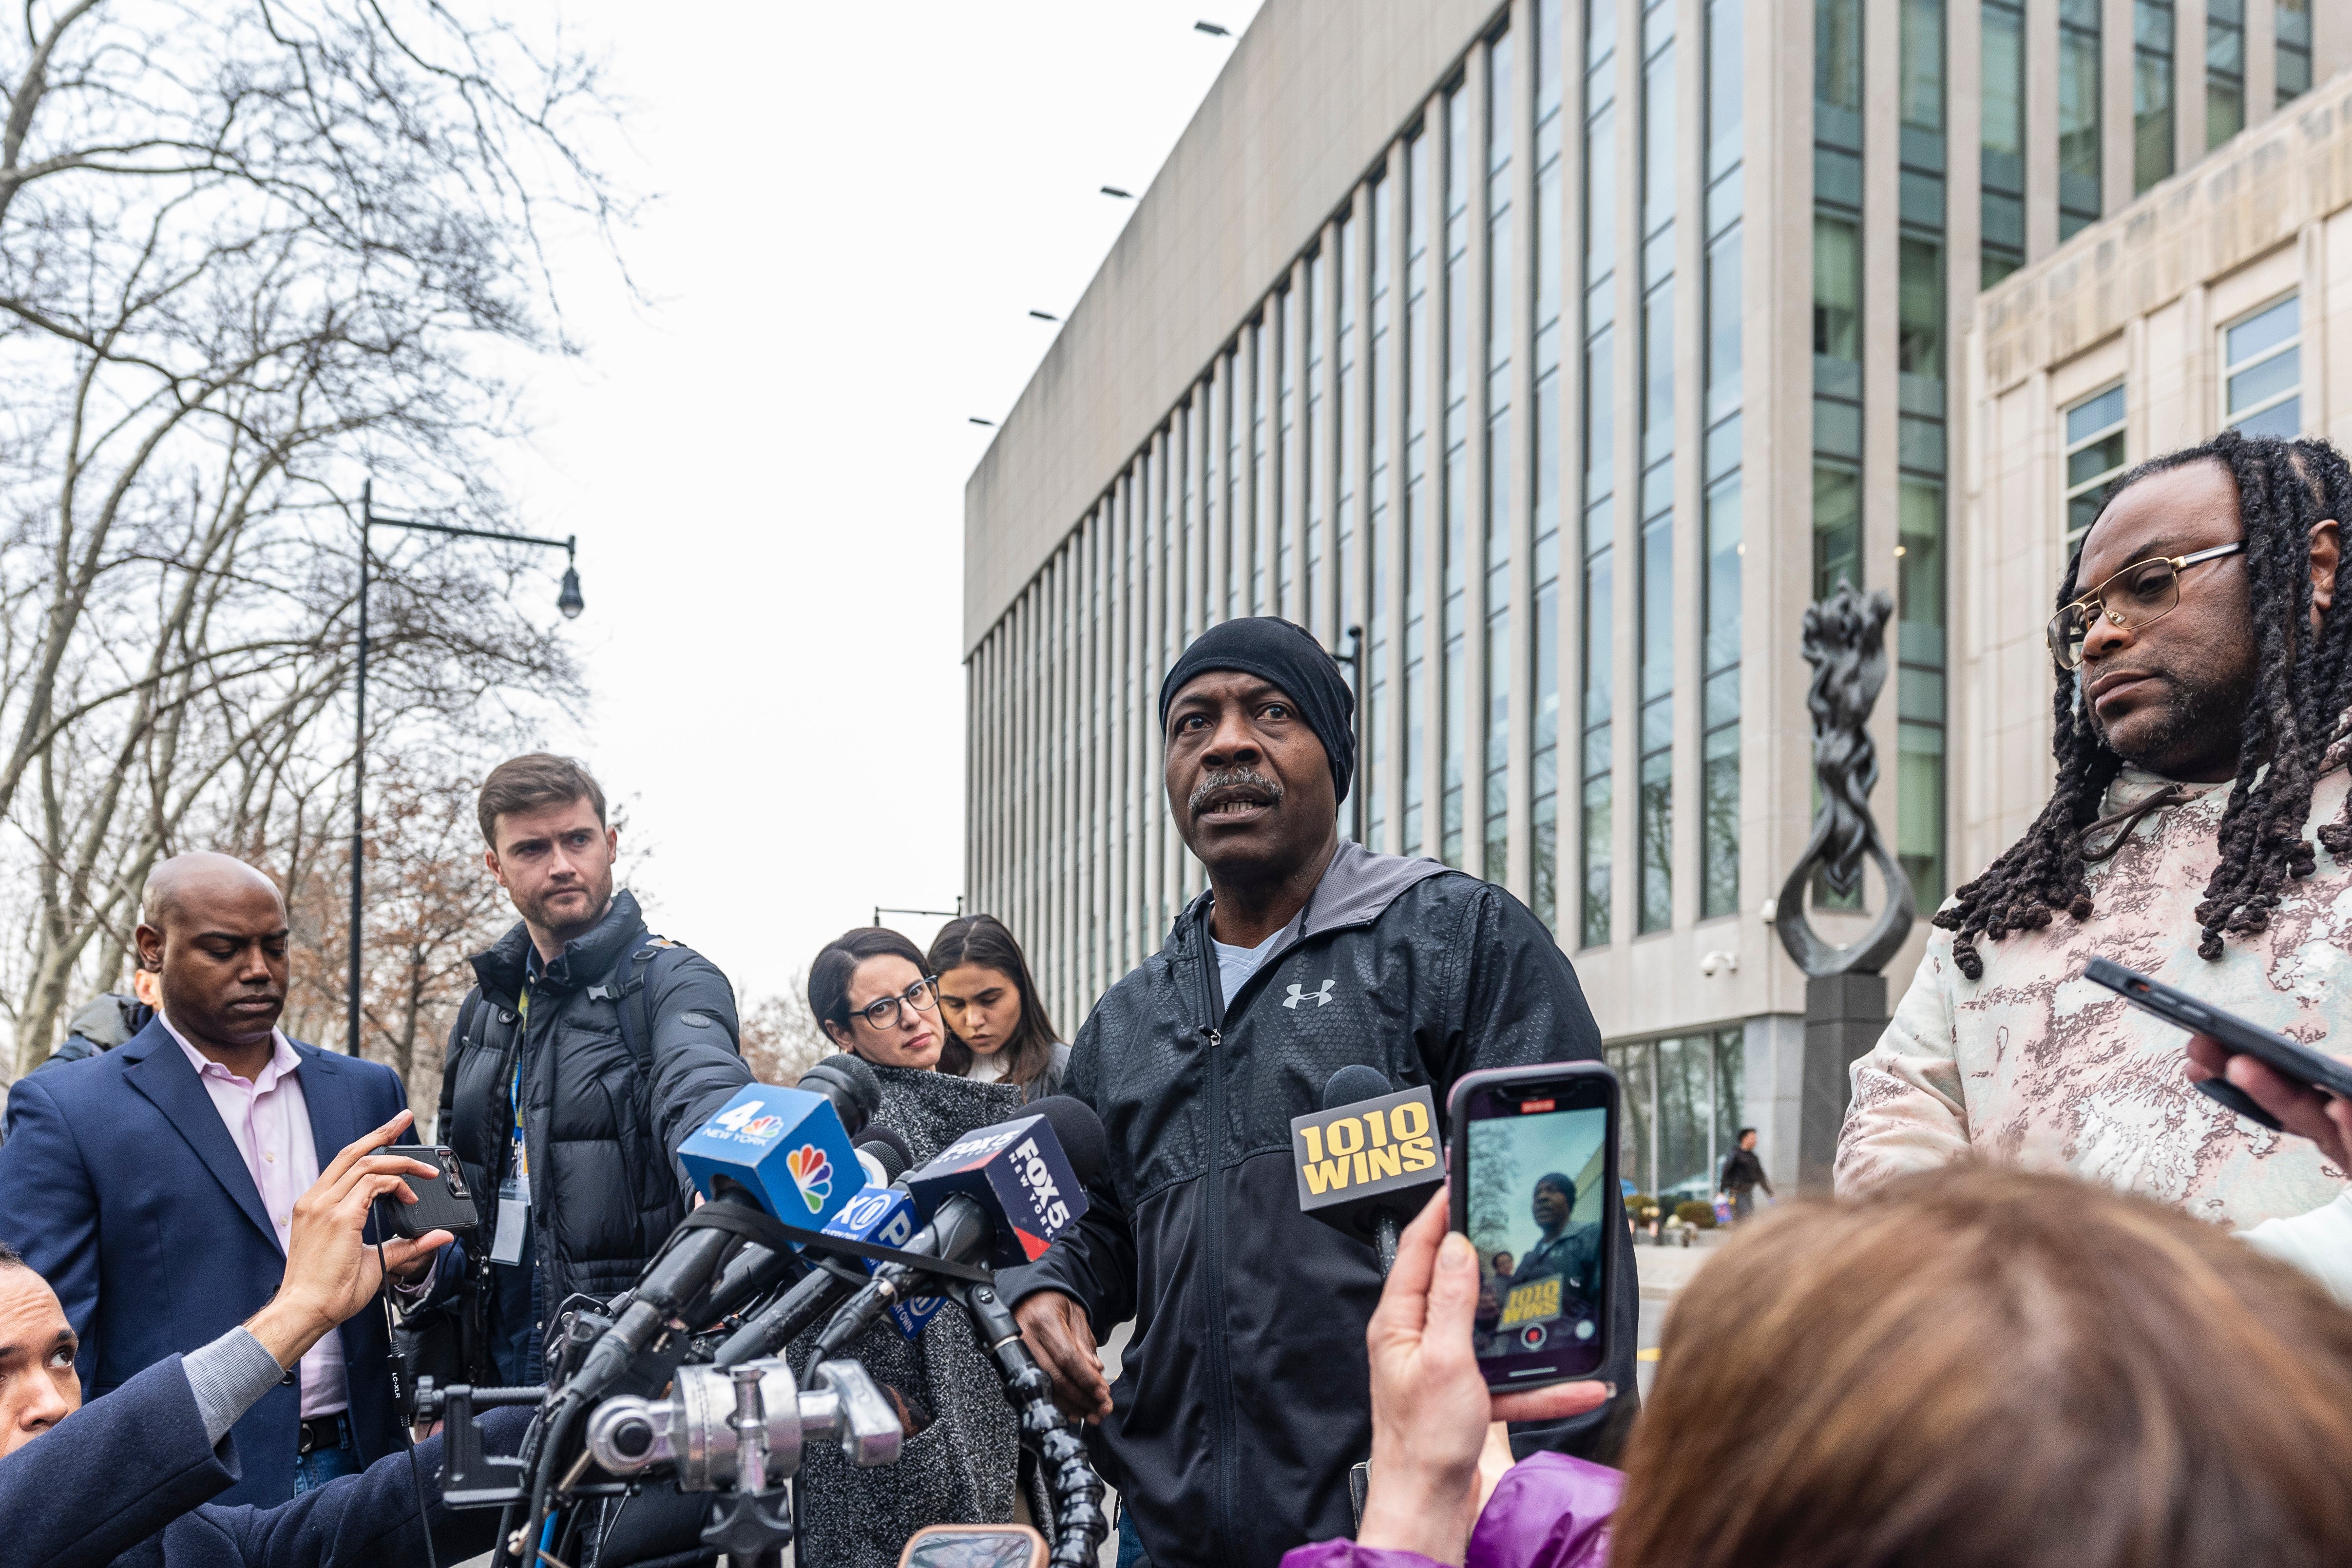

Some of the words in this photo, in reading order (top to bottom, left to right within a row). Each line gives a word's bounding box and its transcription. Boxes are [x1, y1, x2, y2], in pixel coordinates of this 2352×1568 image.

[715, 1100, 765, 1132] 4
[702, 1127, 733, 1140] NEW
[733, 1132, 769, 1147] YORK
[940, 1134, 1002, 1159] FOX
[991, 1129, 1020, 1147] 5
[1300, 1101, 1430, 1164] 1010
[1302, 1136, 1436, 1195] WINS
[1008, 1152, 1030, 1187] NEW
[1029, 1192, 1054, 1238] YORK
[1015, 1136, 1060, 1210] FOX
[1047, 1200, 1071, 1229] 5
[1510, 1280, 1559, 1308] 1010
[899, 1311, 915, 1333] OWN
